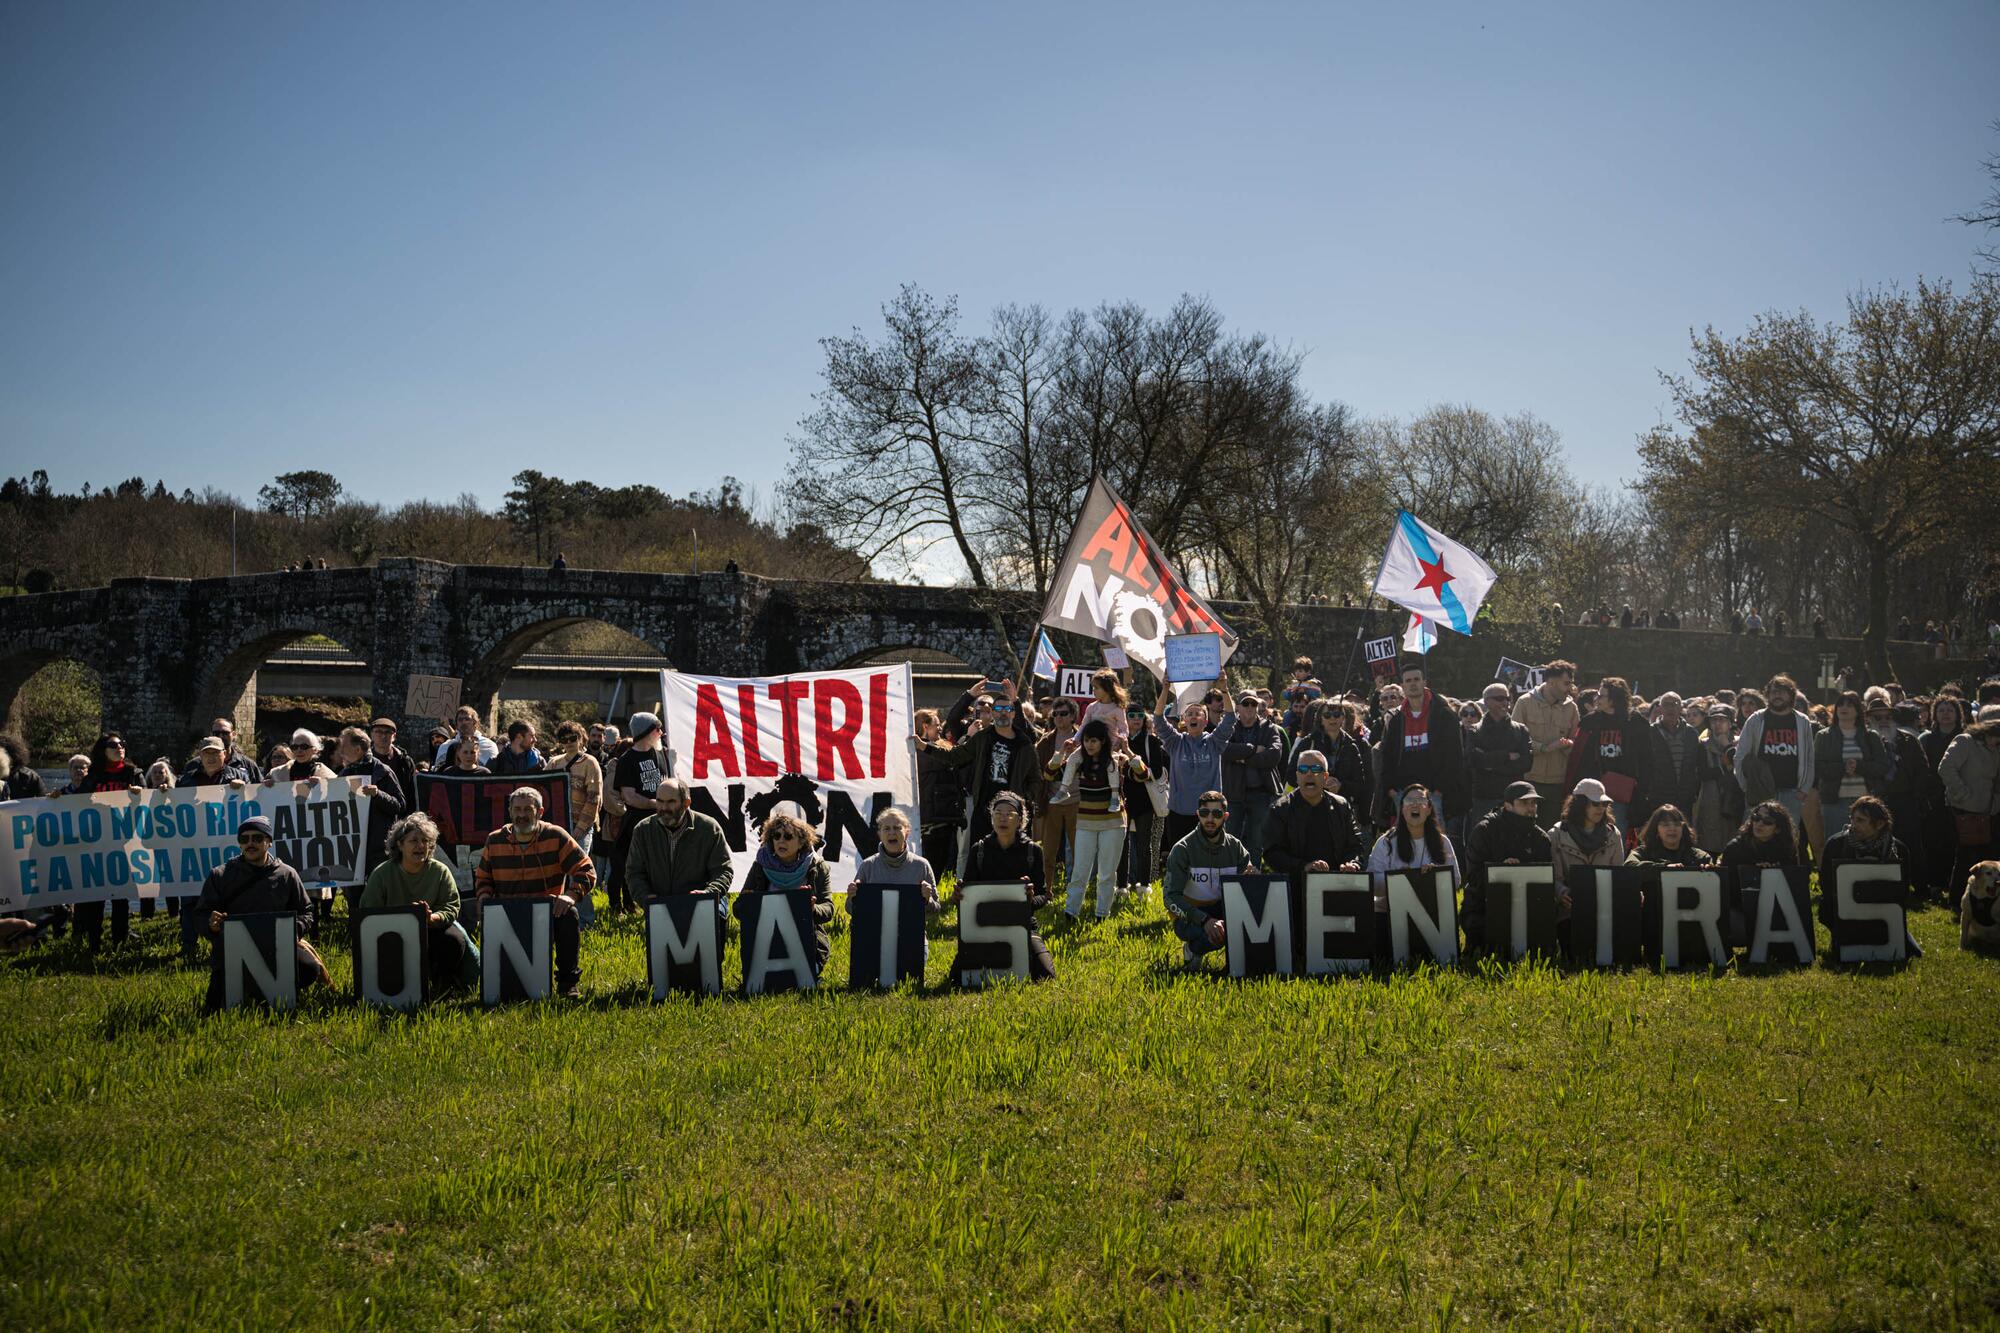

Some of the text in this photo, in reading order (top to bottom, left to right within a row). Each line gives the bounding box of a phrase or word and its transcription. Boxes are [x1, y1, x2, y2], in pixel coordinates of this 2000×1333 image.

[1367, 640, 1394, 660] ALTRI
[412, 680, 459, 705] ALTRI
[693, 674, 889, 782] ALTRI
[1764, 743, 1797, 755] NON
[12, 808, 102, 850] POLO
[111, 803, 197, 841] NOSO
[273, 800, 361, 841] ALTRI
[689, 772, 892, 863] NON
[20, 858, 39, 895] E
[48, 855, 73, 892] A
[80, 848, 174, 889] NOSA
[224, 864, 1906, 1008] NON MAIS MENTIRAS
